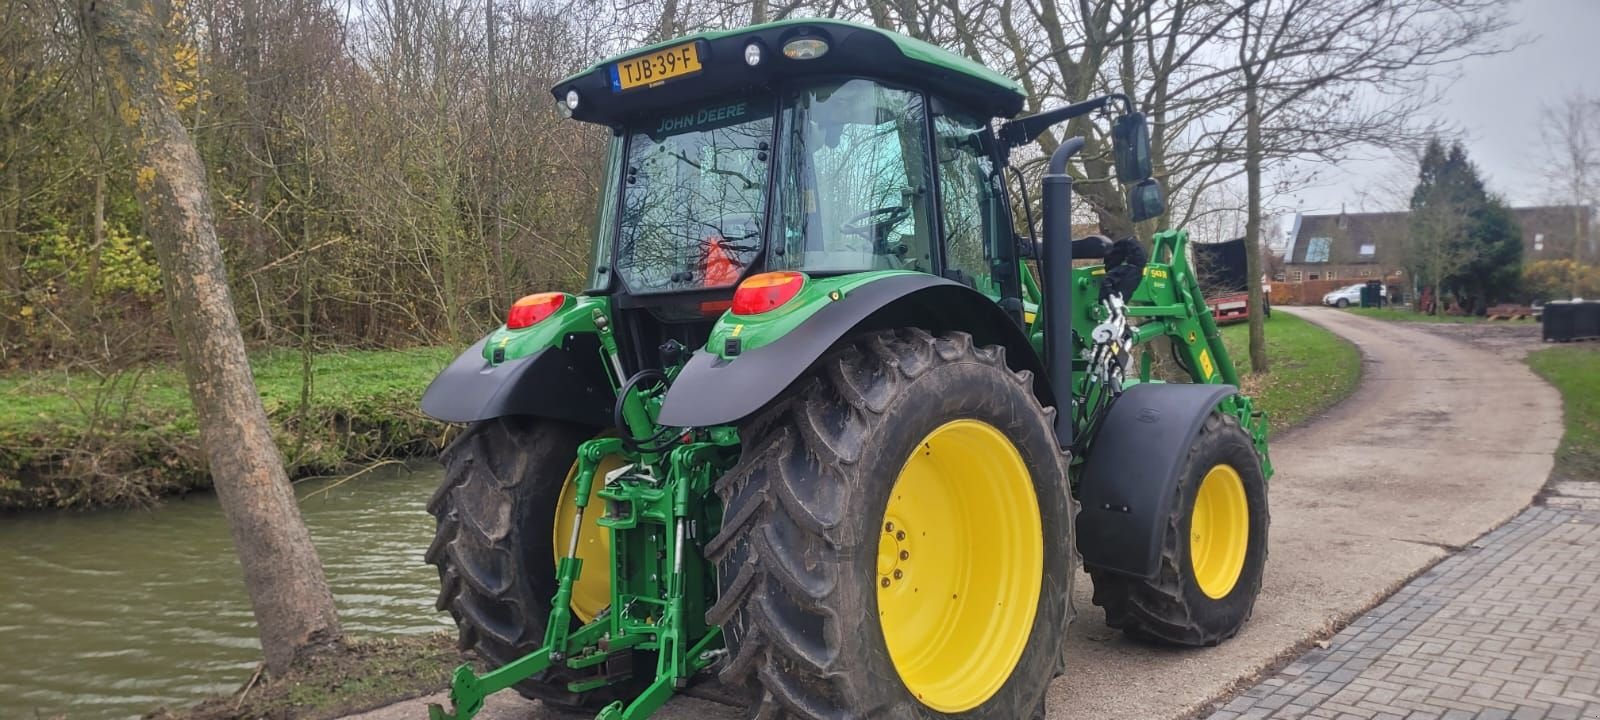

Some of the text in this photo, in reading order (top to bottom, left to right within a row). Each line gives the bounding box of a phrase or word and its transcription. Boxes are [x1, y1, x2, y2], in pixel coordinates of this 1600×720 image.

[623, 47, 691, 84] TJB-39-F
[656, 103, 746, 133] JOHN DEERE
